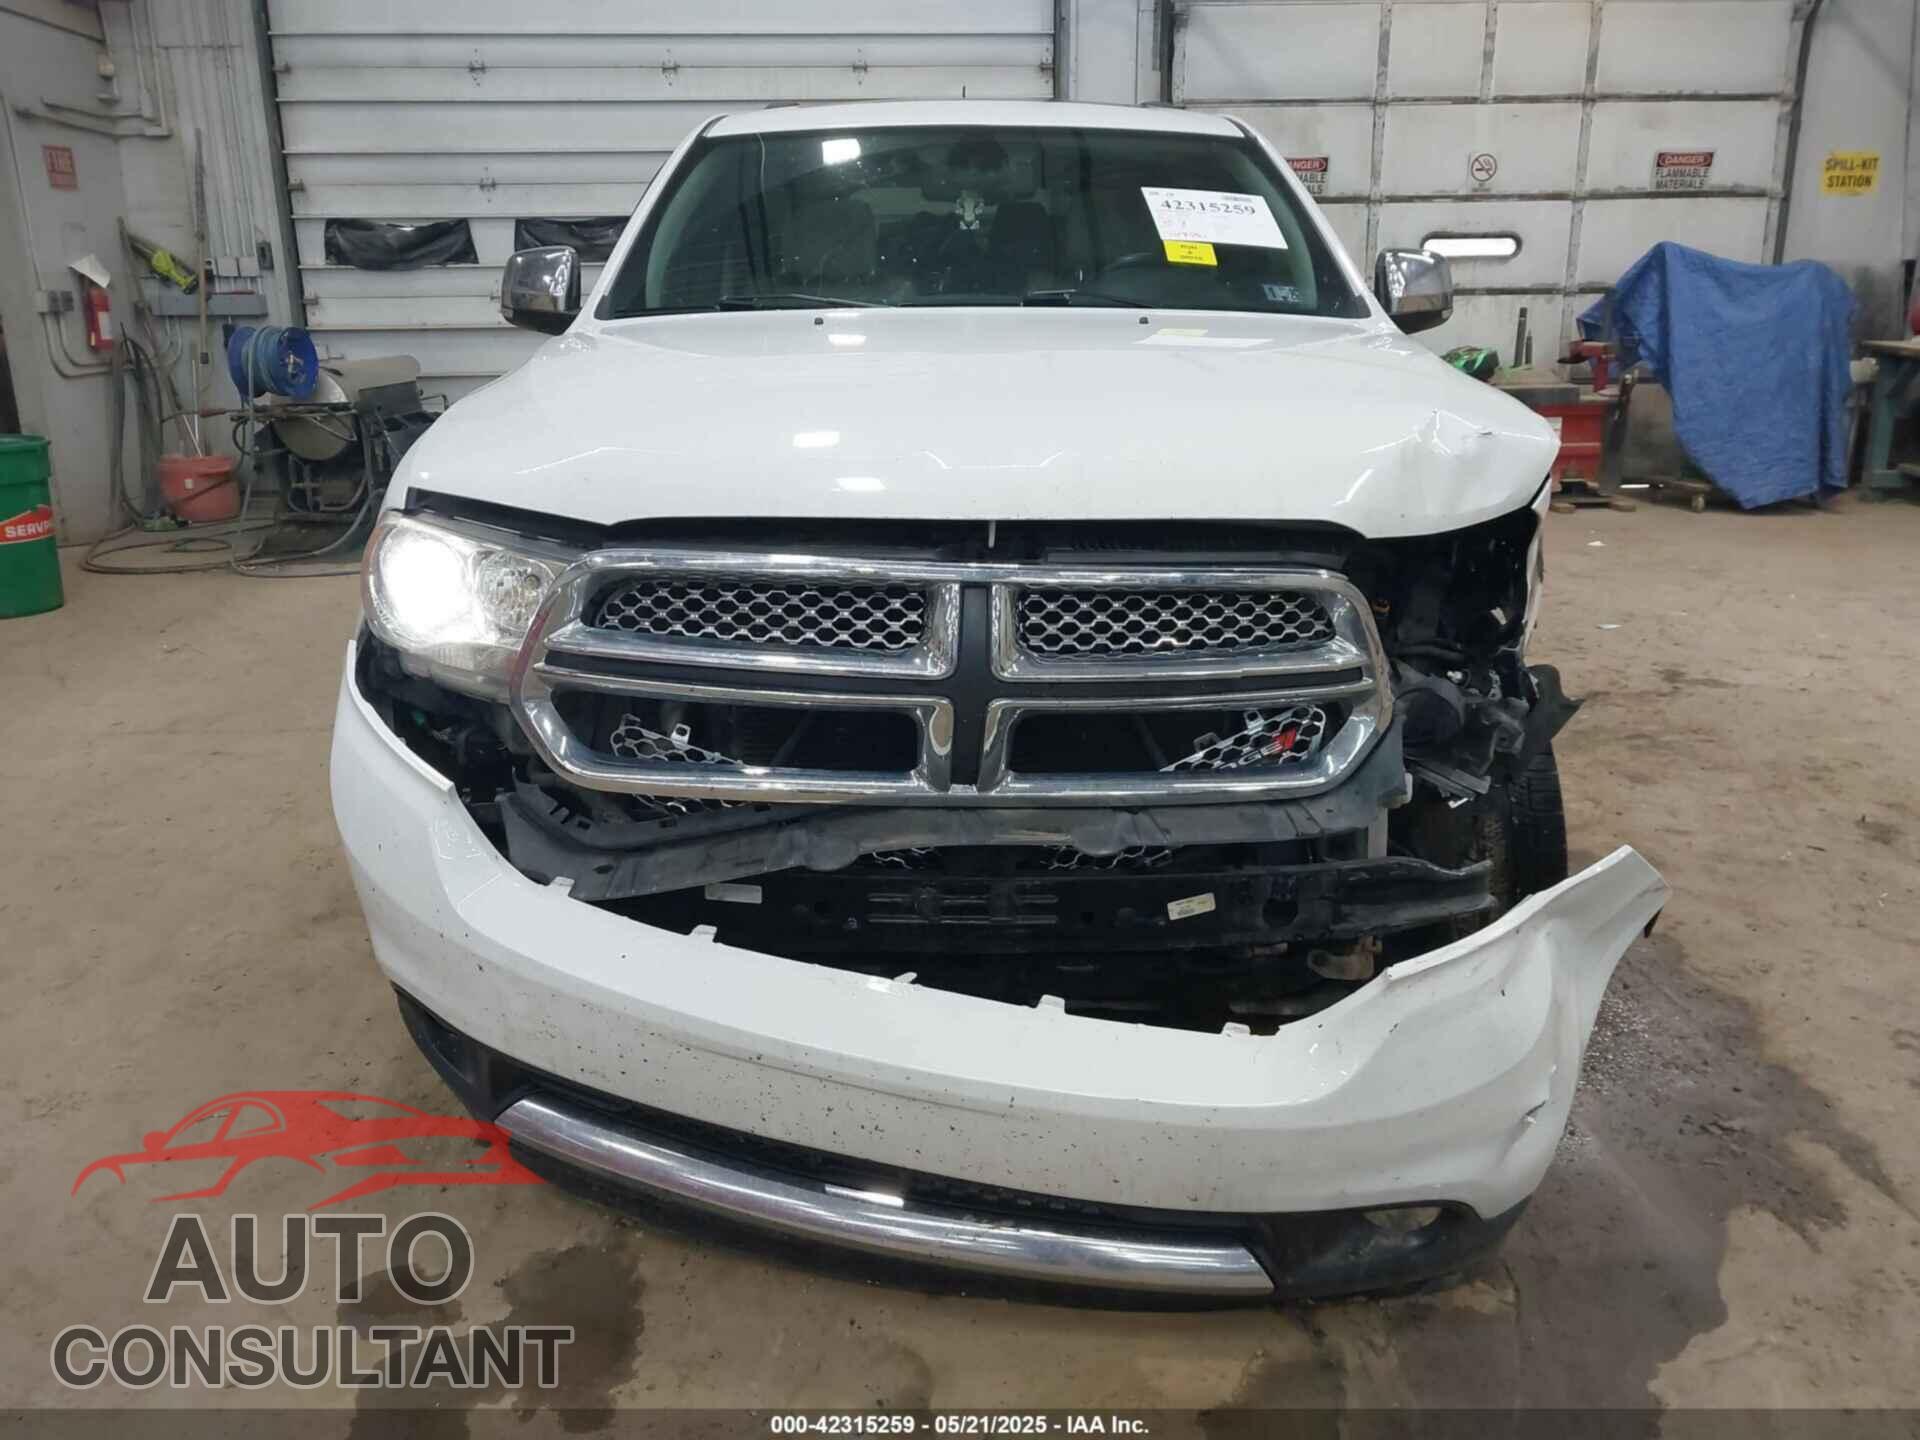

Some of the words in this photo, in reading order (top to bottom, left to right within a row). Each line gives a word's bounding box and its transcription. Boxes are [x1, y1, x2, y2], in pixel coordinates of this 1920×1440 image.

[1664, 154, 1705, 165] DANGER
[1656, 167, 1709, 178] FLAMMABLE
[1656, 178, 1705, 190] MATERIALS
[1827, 175, 1872, 188] STATION
[1161, 199, 1256, 215] 42315259
[5, 519, 49, 538] SERVP
